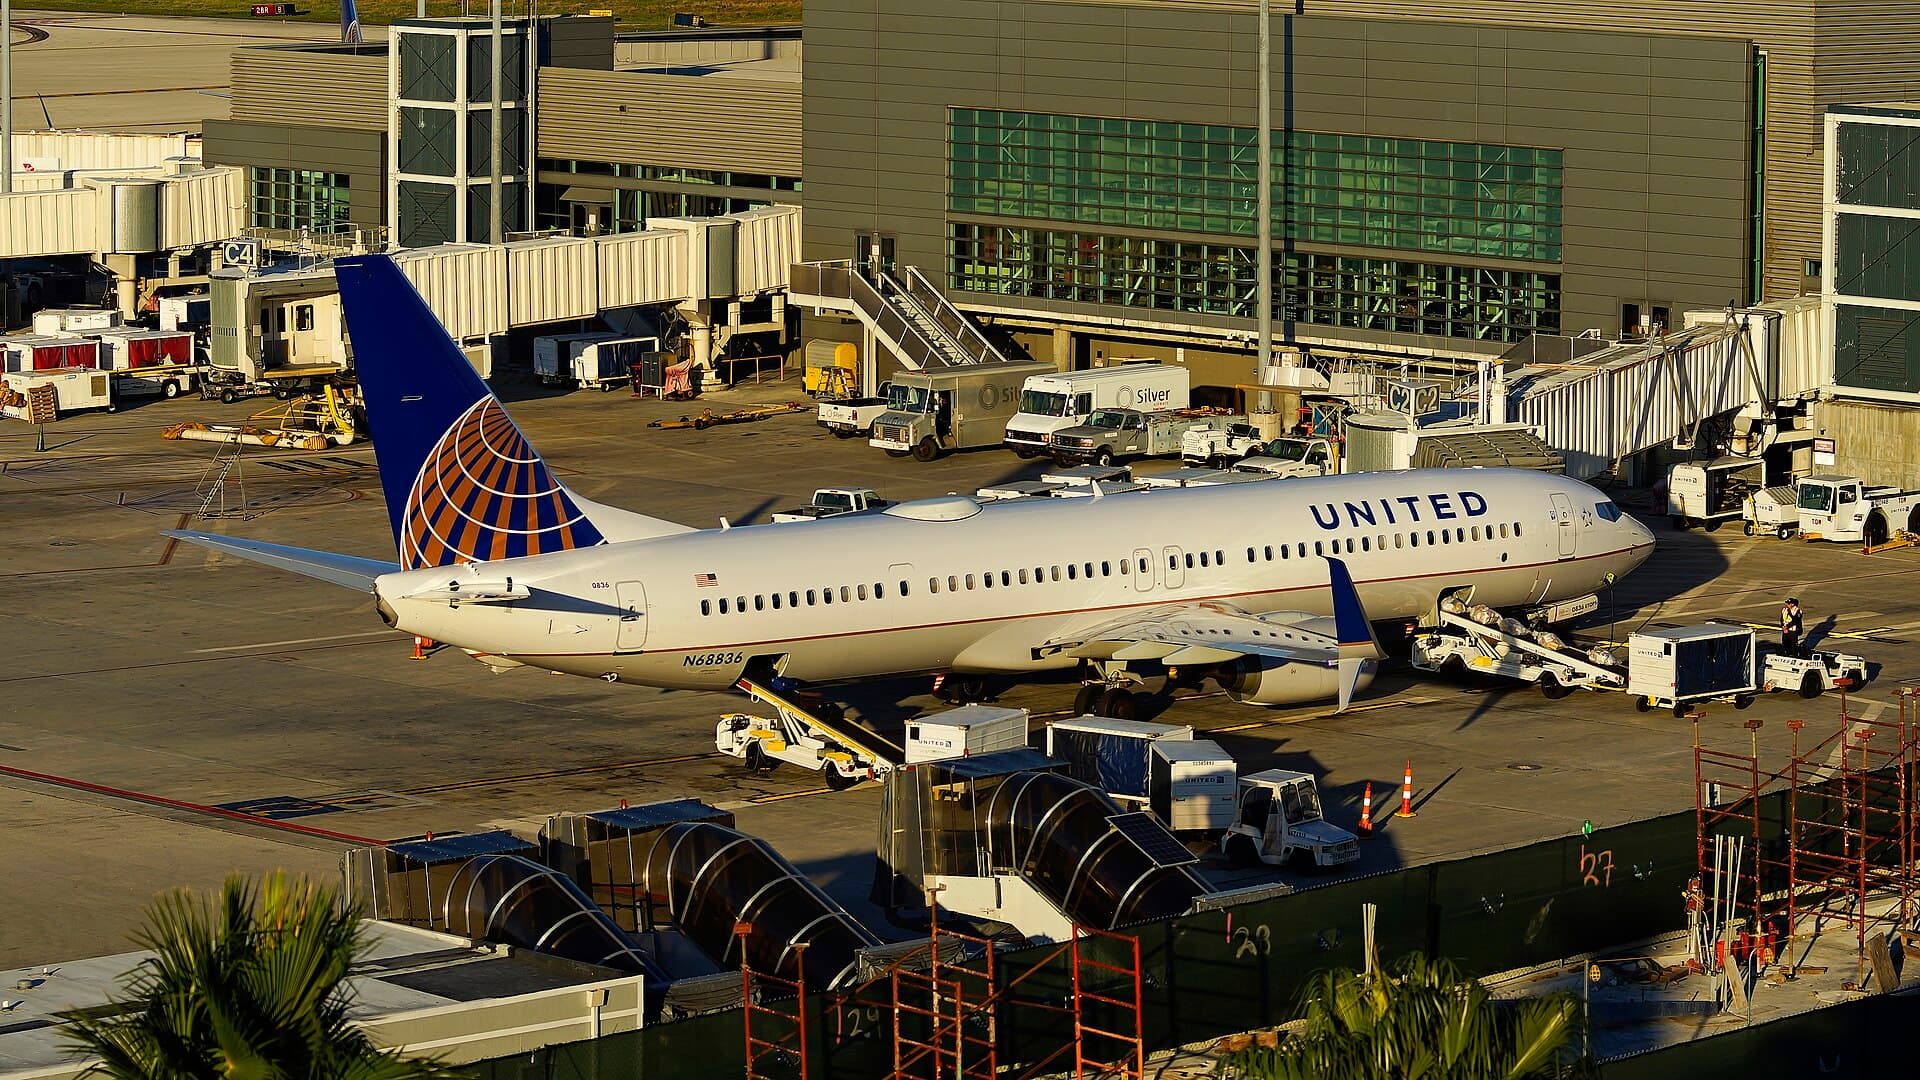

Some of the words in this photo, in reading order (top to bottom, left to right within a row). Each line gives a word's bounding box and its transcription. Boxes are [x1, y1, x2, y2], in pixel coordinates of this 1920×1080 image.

[256, 6, 269, 14] 28R
[225, 243, 252, 264] C4
[1137, 387, 1170, 404] Silver
[1389, 385, 1411, 412] C2
[1416, 386, 1438, 413] C2
[1310, 491, 1488, 530] UNITED
[1571, 604, 1584, 612] 0836
[682, 651, 744, 667] N68836
[918, 739, 945, 747] UNITED
[1184, 776, 1216, 784] UNITED
